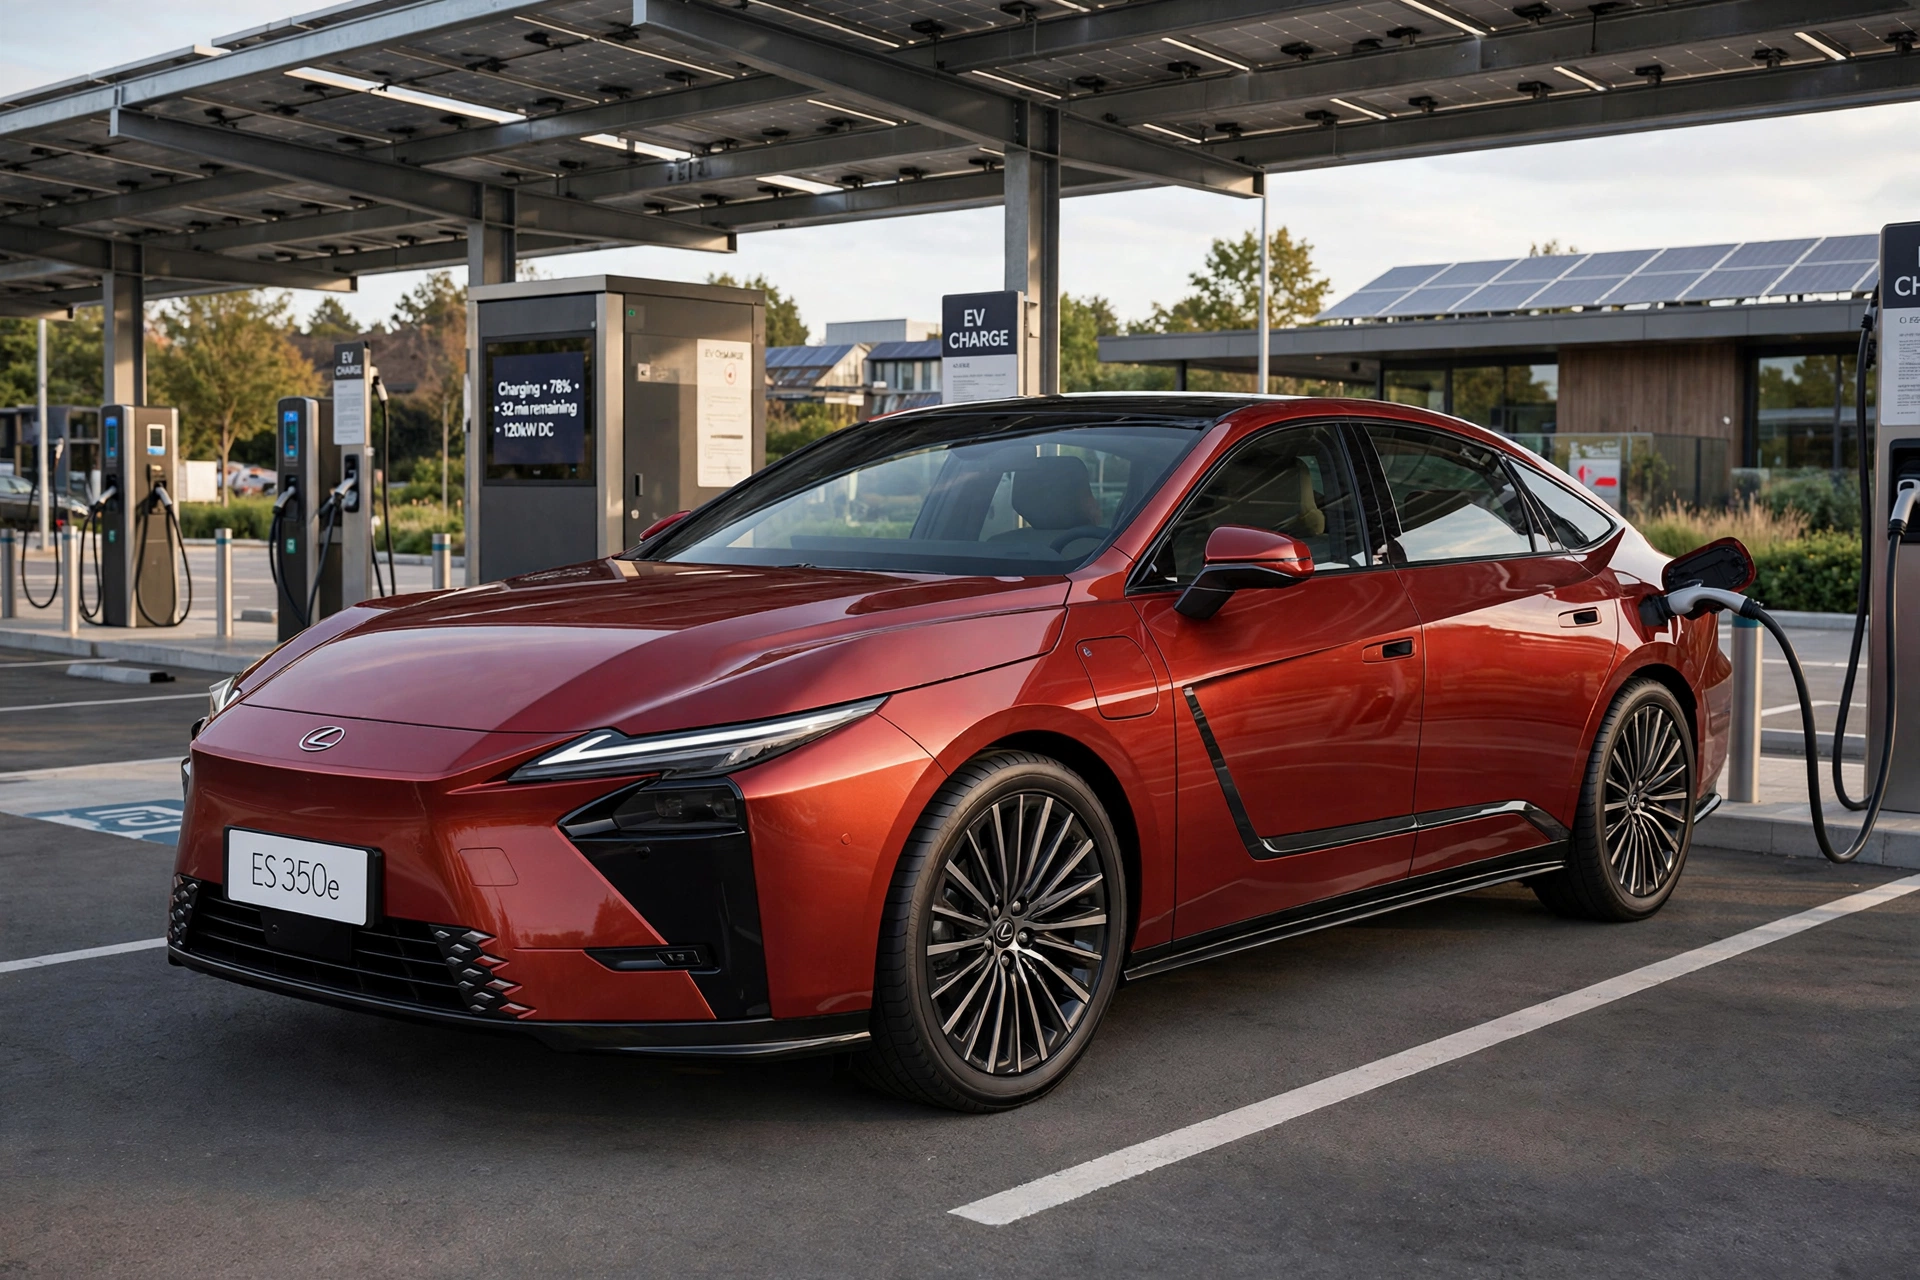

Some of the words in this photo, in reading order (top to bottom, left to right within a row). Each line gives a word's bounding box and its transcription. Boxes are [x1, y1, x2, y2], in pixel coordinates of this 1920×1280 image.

[963, 307, 986, 328] EV
[948, 329, 1009, 349] CHARGE
[341, 351, 354, 364] EV
[497, 380, 541, 399] Charging
[549, 379, 572, 394] 78%
[500, 401, 514, 417] 32
[529, 399, 578, 417] remaining
[538, 422, 555, 437] DC
[252, 852, 277, 889] ES
[281, 857, 340, 900] 350e
